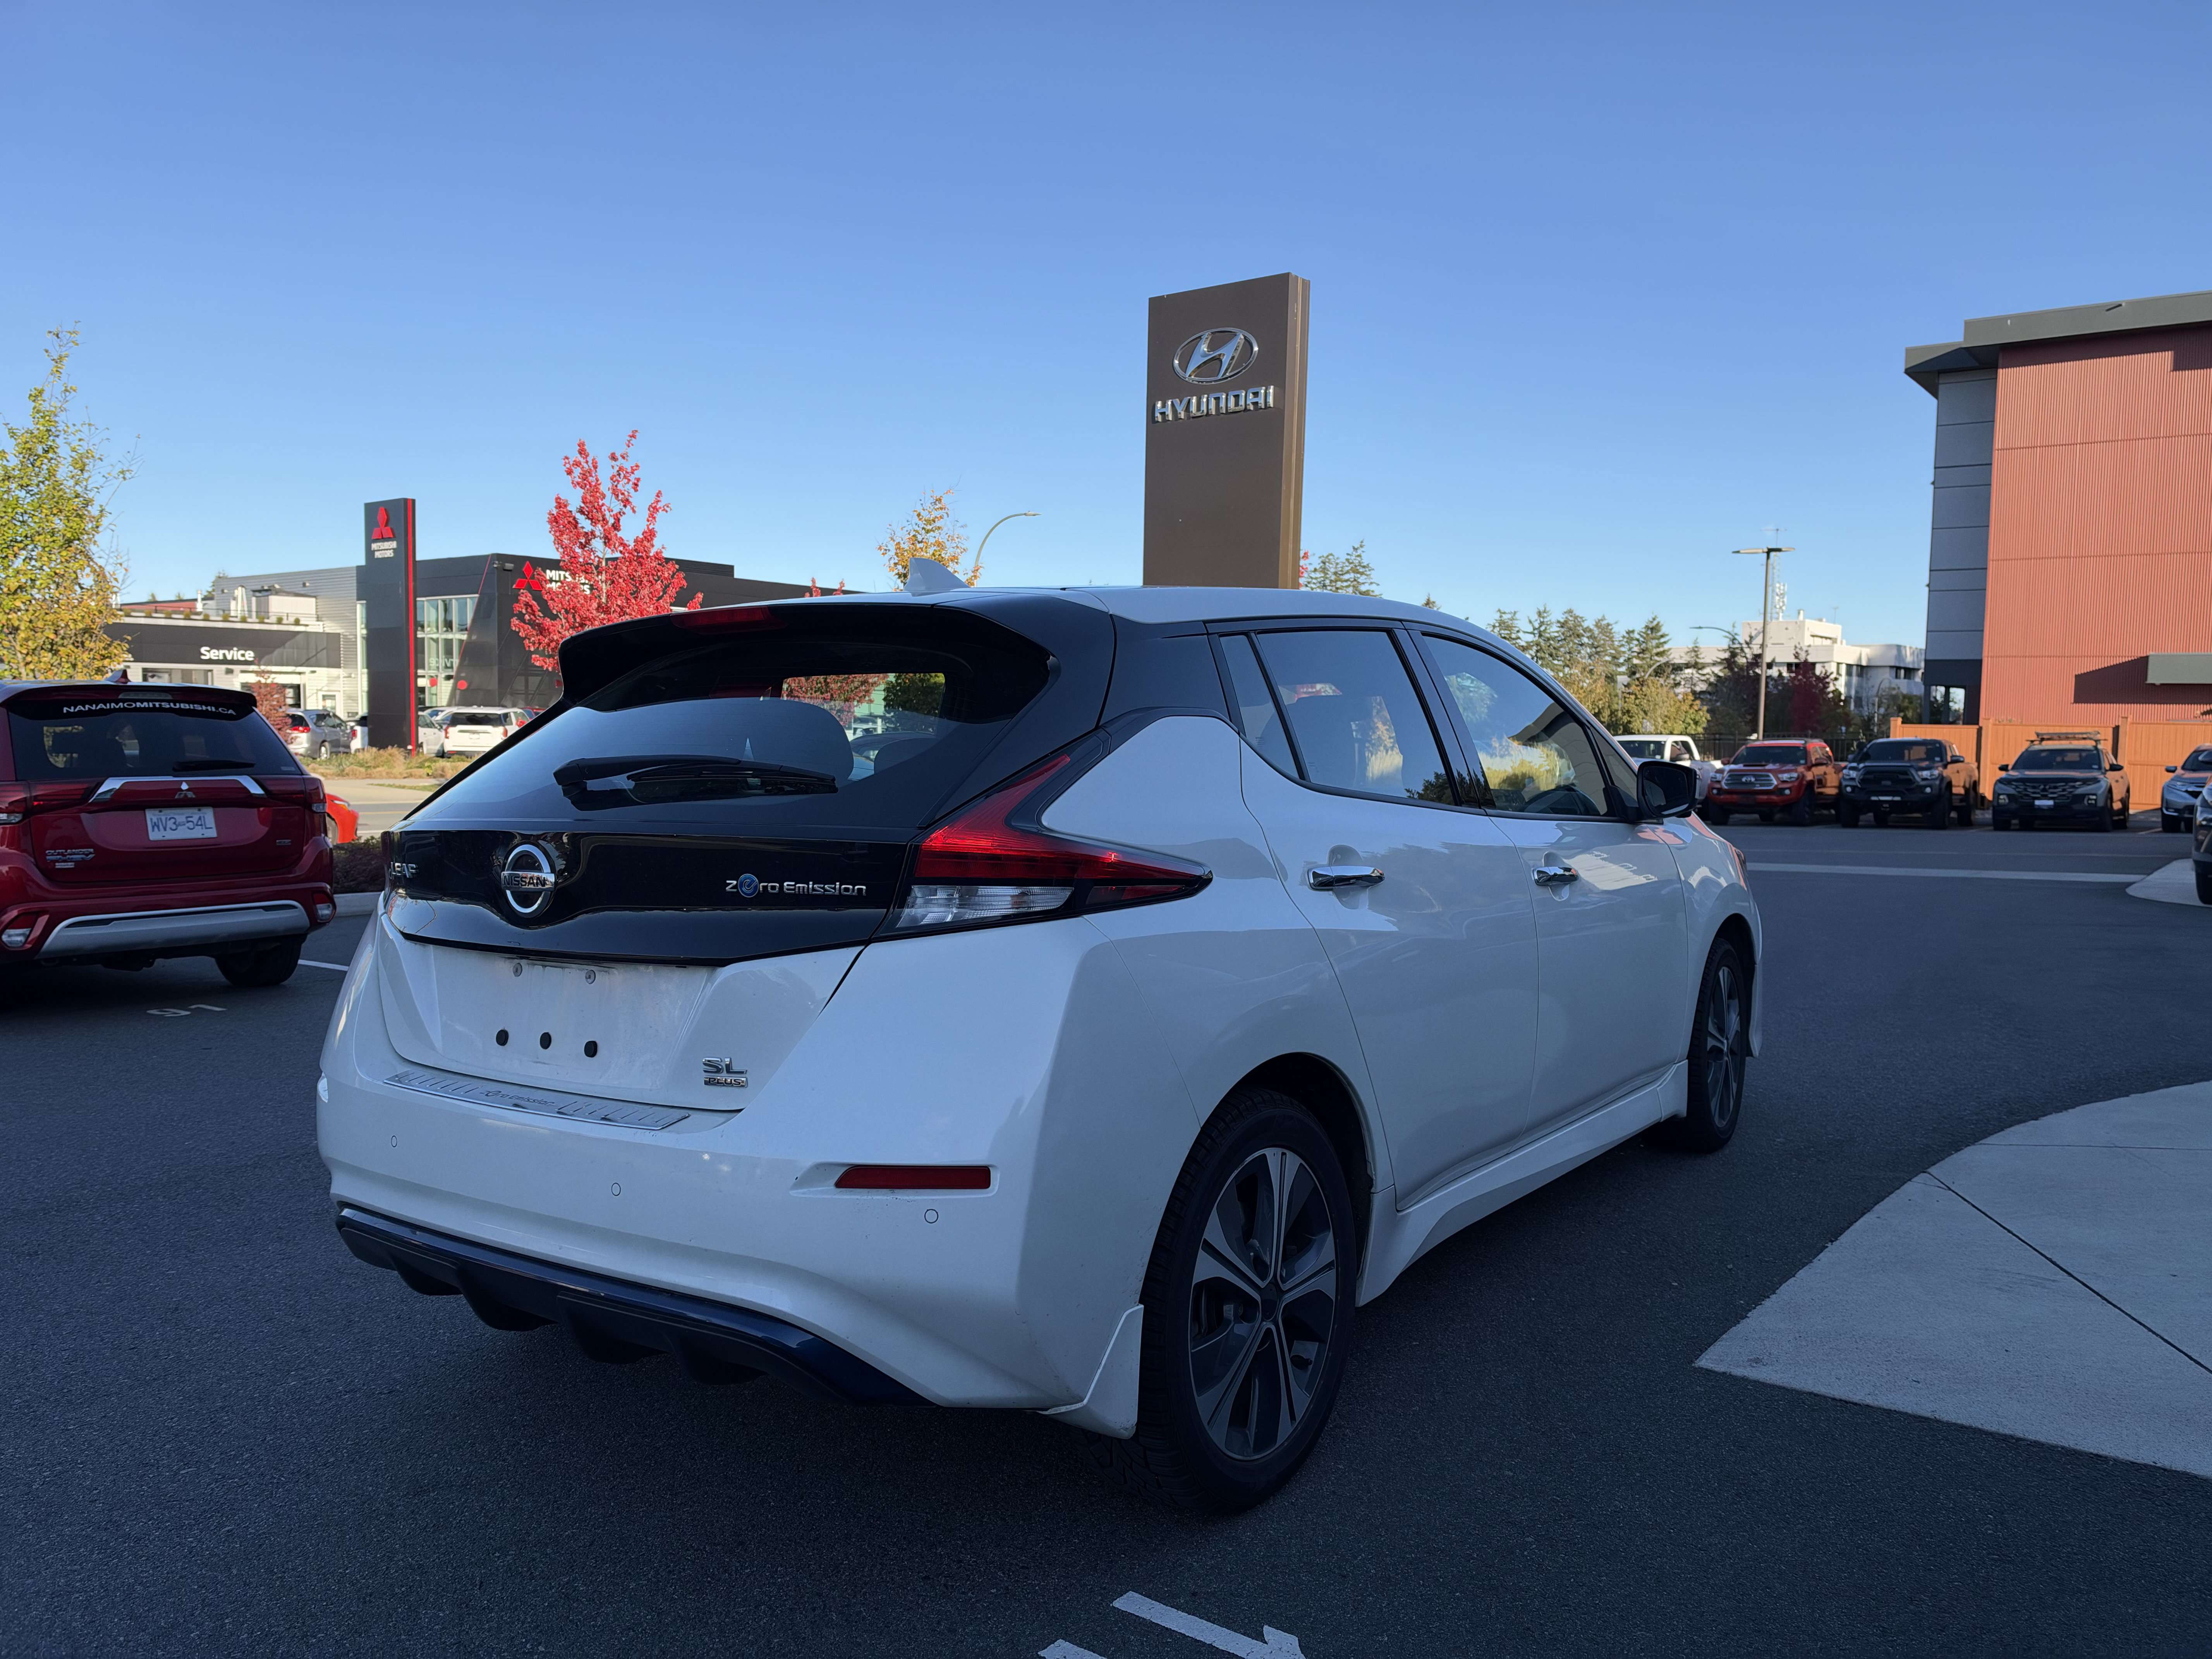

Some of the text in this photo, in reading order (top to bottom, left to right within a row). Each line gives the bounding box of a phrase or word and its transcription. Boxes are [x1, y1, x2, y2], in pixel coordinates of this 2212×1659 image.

[1153, 385, 1274, 423] HYUNDAI
[371, 541, 397, 550] MITSUBISHI
[374, 549, 394, 558] MOTORS
[200, 646, 255, 661] Service
[63, 702, 236, 715] NANAIMOMITSUBISHI.CA
[390, 862, 417, 878] LEAF
[503, 875, 546, 887] NISSAN
[783, 881, 866, 896] Emission
[702, 1057, 747, 1074] SL
[708, 1078, 741, 1086] PLUS
[508, 1095, 555, 1106] Emission
